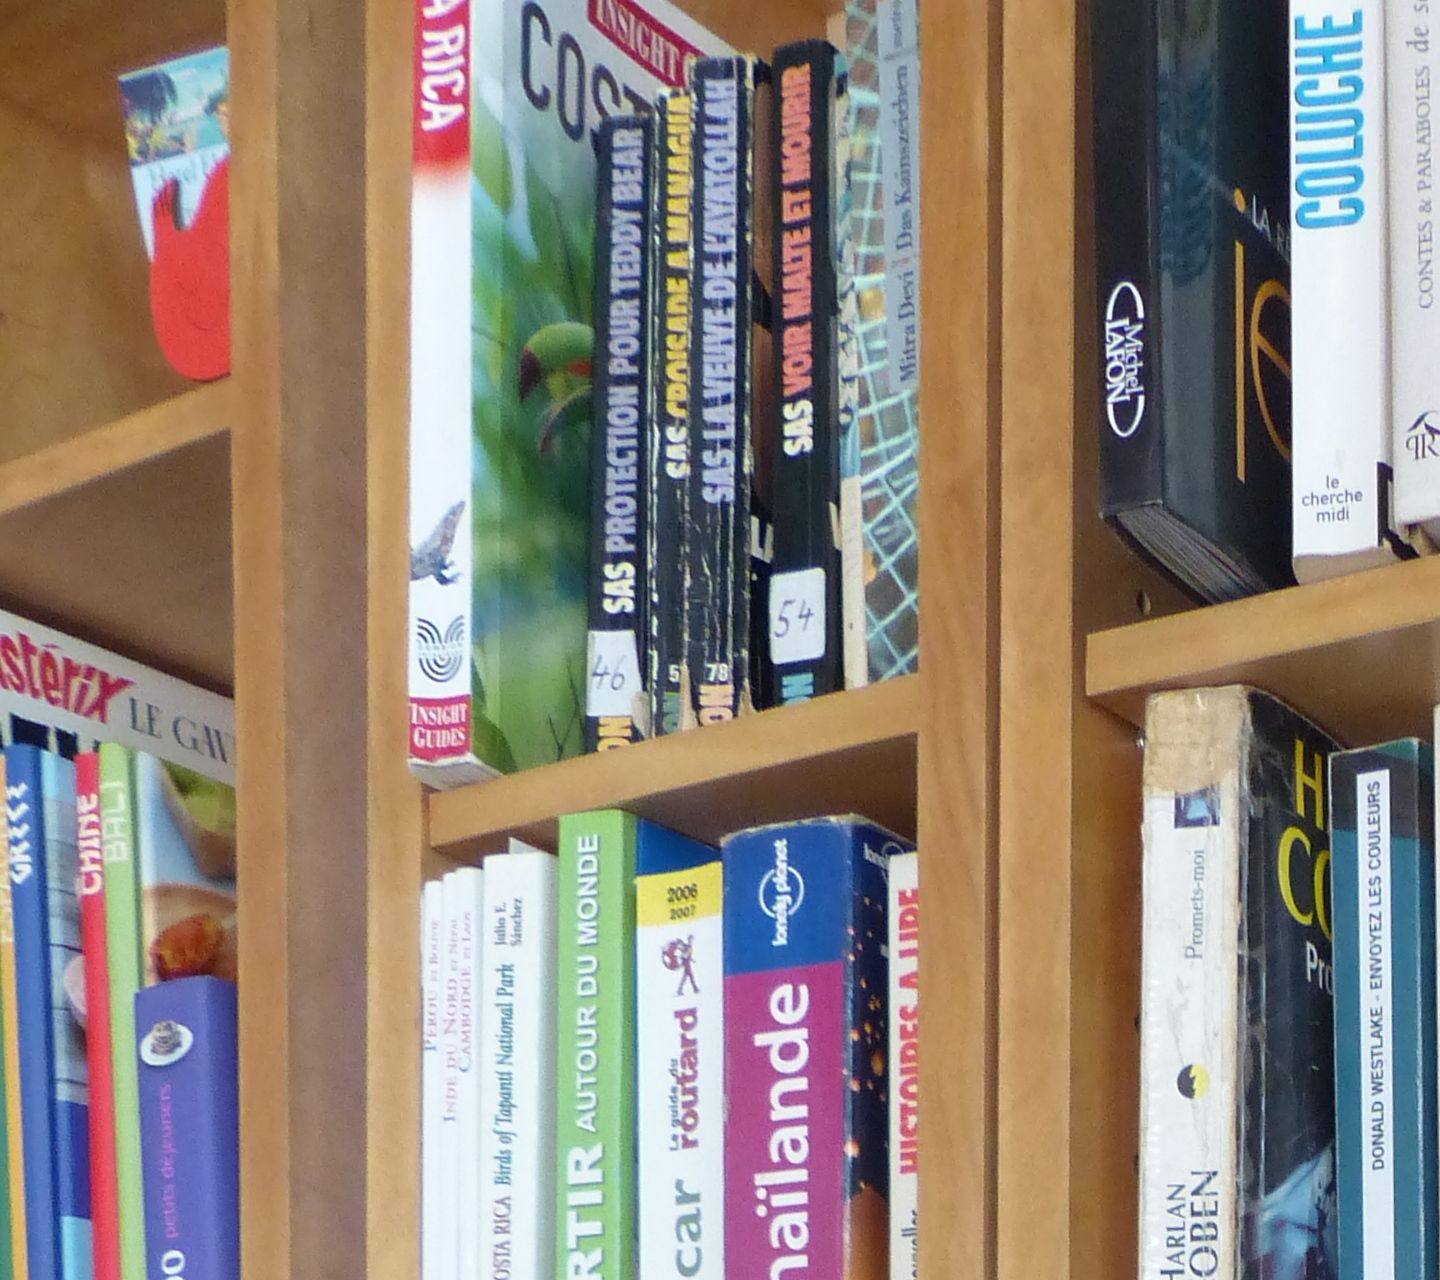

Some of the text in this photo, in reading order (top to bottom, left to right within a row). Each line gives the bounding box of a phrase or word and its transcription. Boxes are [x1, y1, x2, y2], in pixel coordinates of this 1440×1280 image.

[420, 24, 465, 132] RICA
[1293, 9, 1365, 230] COLUCHE
[602, 127, 644, 614] SAS PROTECTION POUR TEDDY BEAR
[701, 78, 738, 504] SAS LA VEUVE DE L'AYATOLLAH
[781, 62, 814, 457] SAS VOIR MALTE ET MOURIR
[76, 792, 102, 896] CHINE
[575, 833, 600, 1132] AUTOUR DU MONDE
[1184, 848, 1206, 959] Promets-moi
[1366, 780, 1386, 1171] DONALD WESTLAKE ENVOYEZ LES COULEURS
